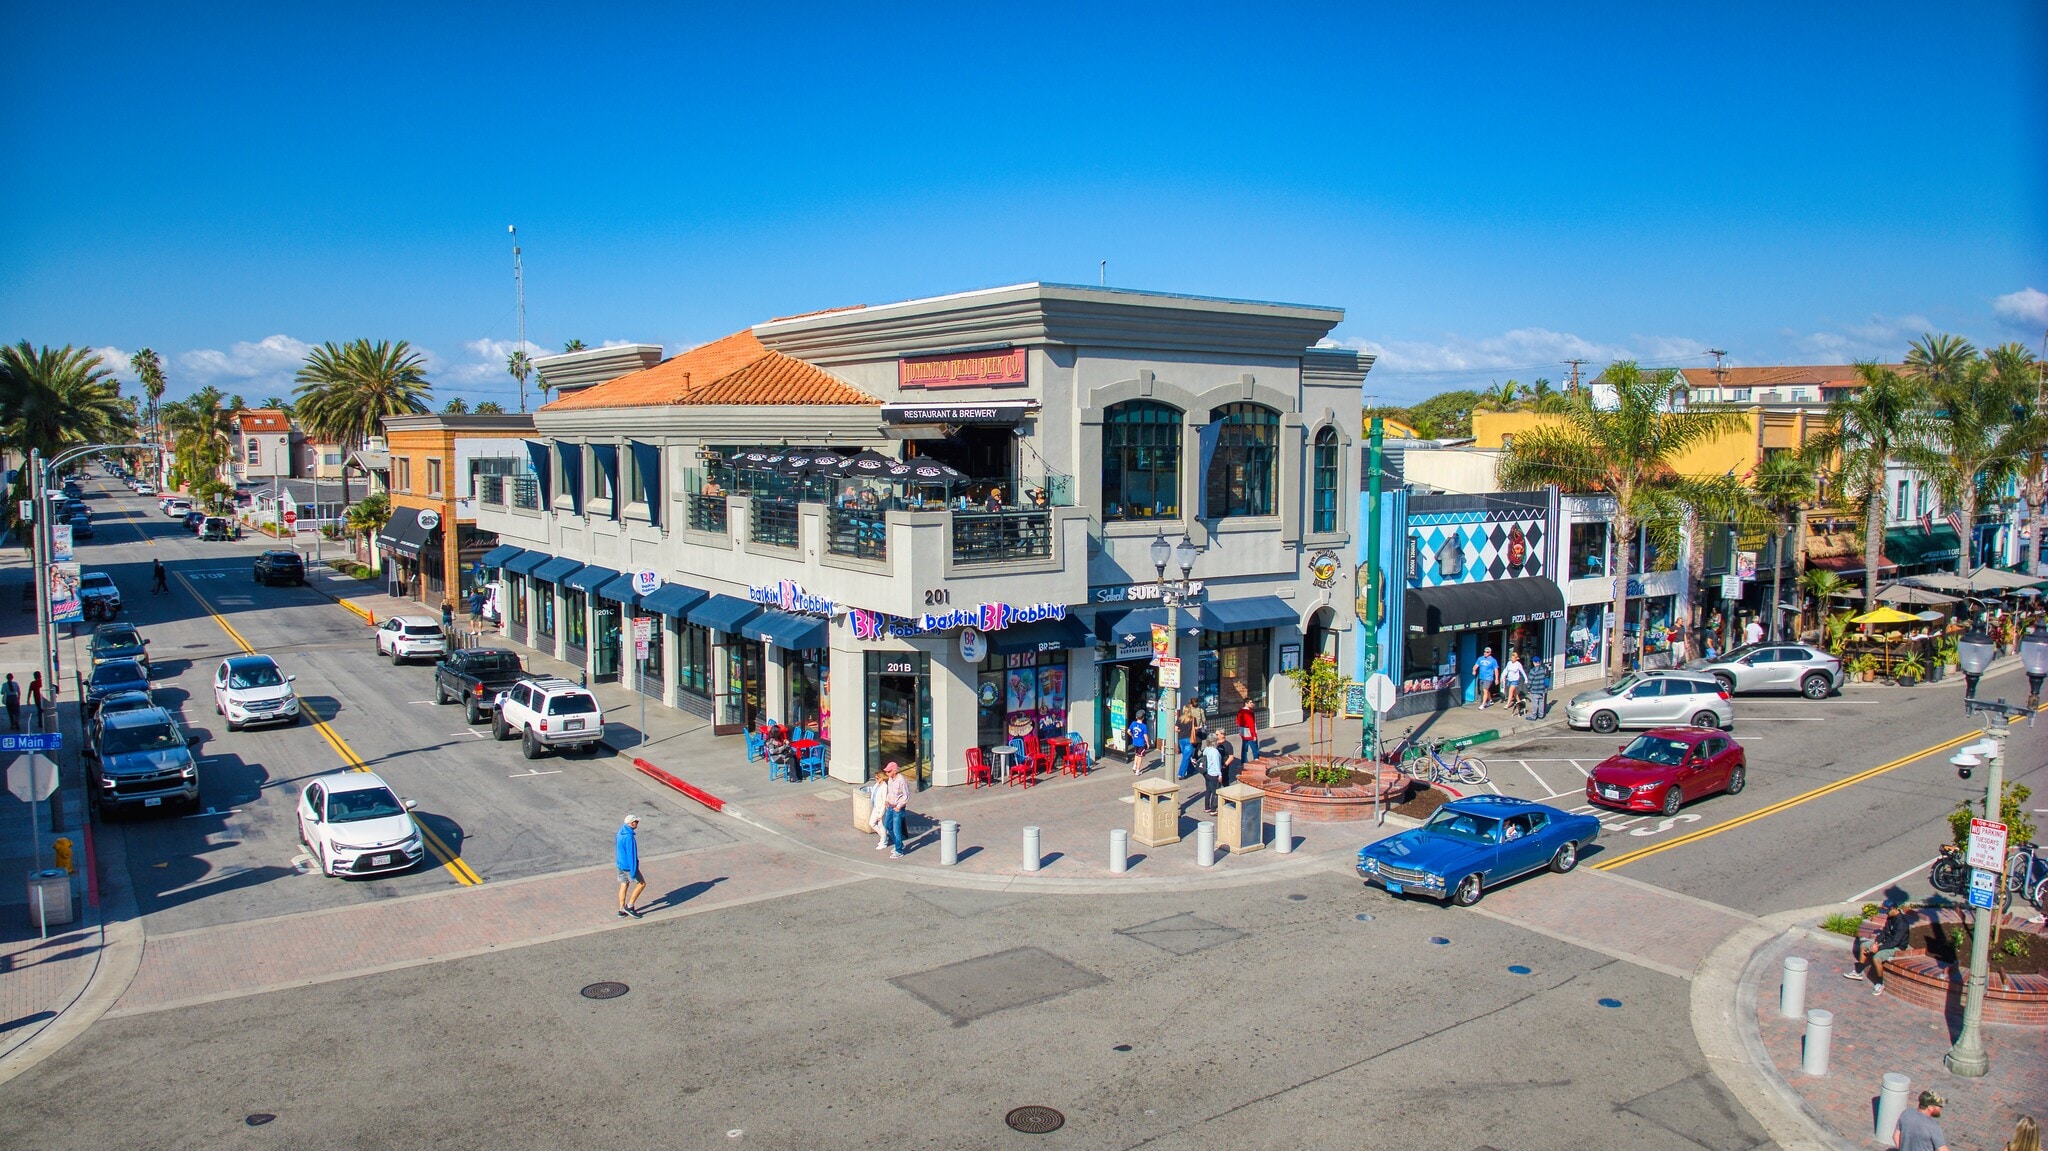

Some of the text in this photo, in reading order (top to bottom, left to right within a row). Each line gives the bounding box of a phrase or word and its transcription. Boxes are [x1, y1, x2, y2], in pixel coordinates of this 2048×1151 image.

[904, 360, 949, 383] HUNTINGTON
[951, 358, 979, 380] BEACH
[981, 357, 1004, 378] BEER
[904, 409, 997, 419] RESTAURANT & BREWERY
[641, 572, 655, 583] BR
[749, 585, 778, 603] baskin
[799, 594, 834, 616] robbins
[925, 589, 949, 605] 201
[1097, 587, 1125, 603] Sakal
[53, 600, 80, 614] SHOP
[849, 608, 884, 638] BR
[924, 608, 978, 631] baskin
[979, 602, 1011, 632] BR
[1011, 603, 1066, 623] robbins
[1512, 610, 1564, 623] PIZZA PIZZA PIZZA
[964, 631, 976, 646] BR
[1038, 642, 1048, 652] BR
[888, 663, 911, 672] 201B
[18, 737, 44, 748] Main
[1976, 820, 2002, 829] TOW-AWAY
[1971, 825, 2003, 838] NO PARKING
[1975, 836, 1999, 847] TUESDAYS
[1986, 860, 1999, 868] BLOCK
